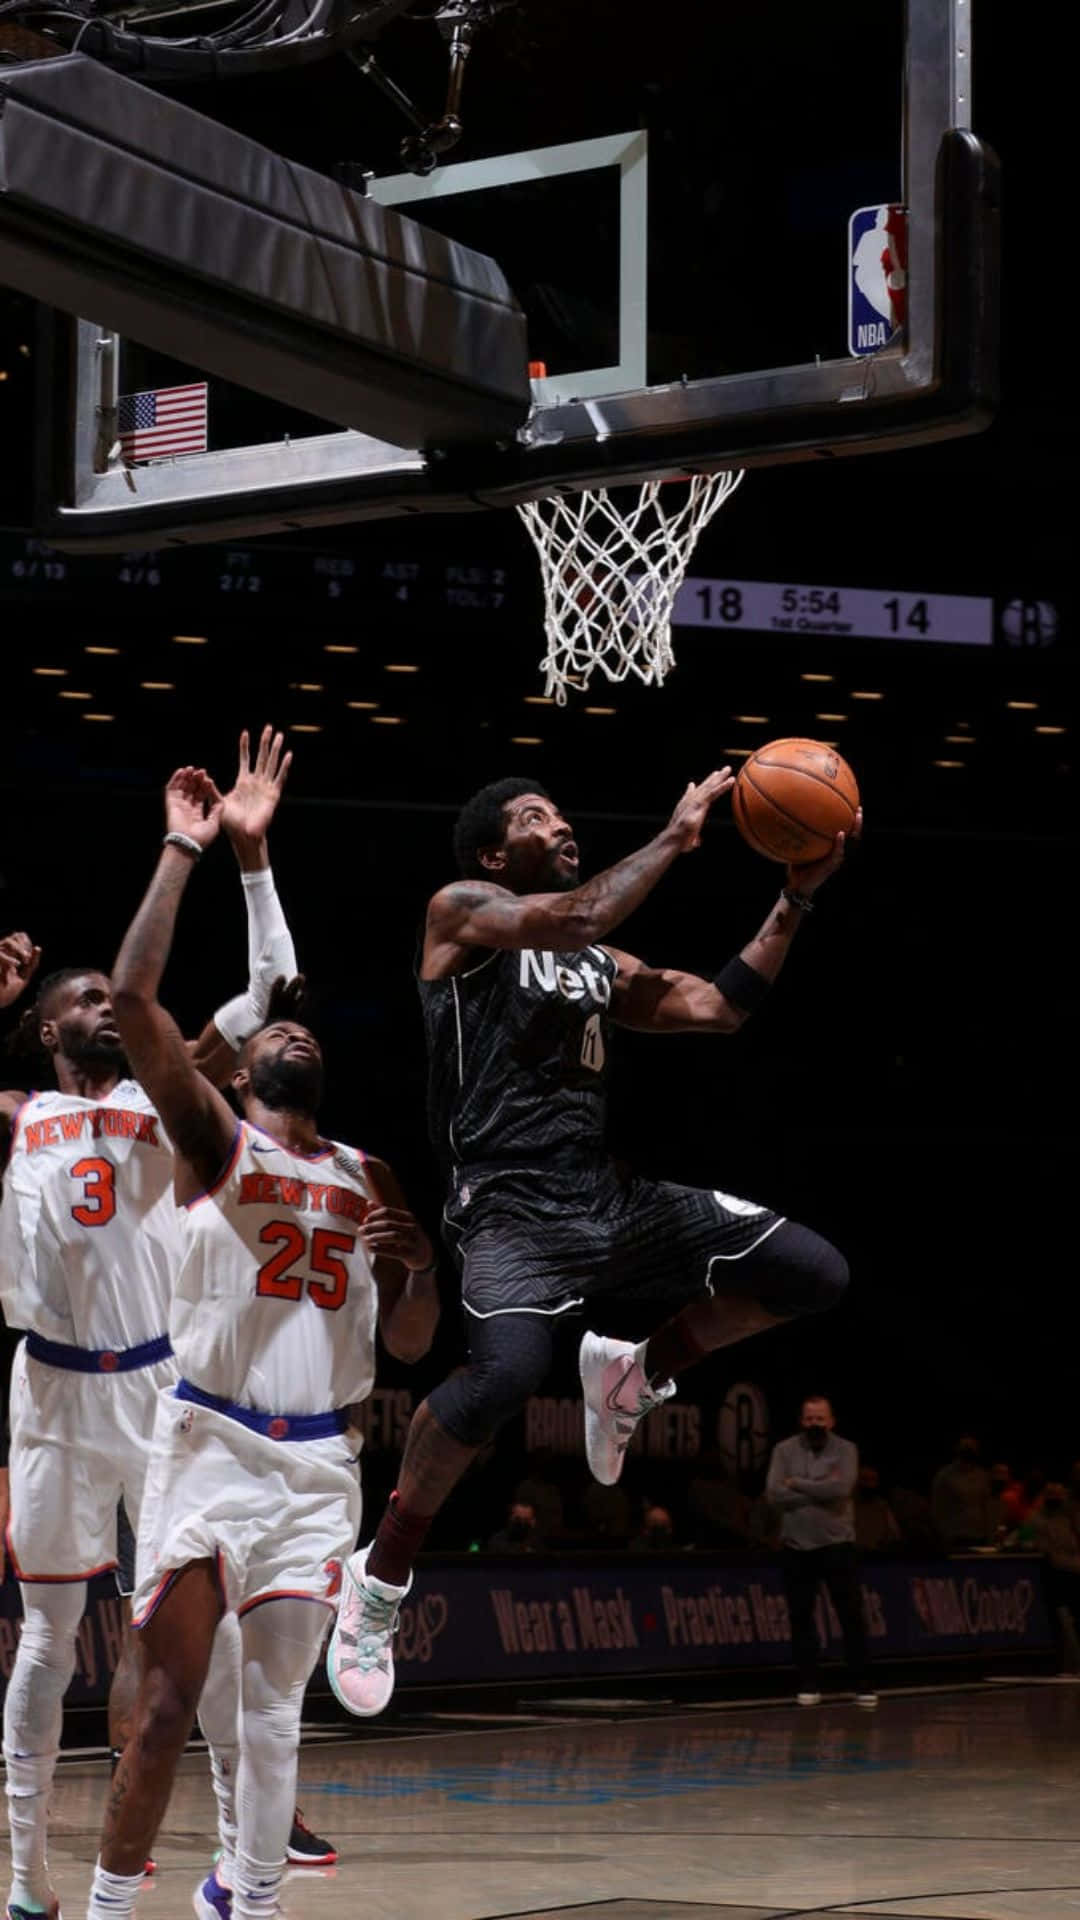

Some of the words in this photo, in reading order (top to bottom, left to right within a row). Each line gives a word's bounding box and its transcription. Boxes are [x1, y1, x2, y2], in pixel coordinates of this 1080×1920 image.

[857, 321, 886, 348] NBA
[696, 585, 743, 622] 18
[782, 589, 841, 615] 5:54
[884, 598, 930, 635] 14
[772, 617, 794, 630] 1st
[797, 619, 854, 633] Quarter
[25, 1112, 83, 1154] NEW
[87, 1108, 159, 1147] YORK
[71, 1157, 116, 1227] 3
[239, 1172, 304, 1206] NEW
[256, 1221, 355, 1310] 25
[489, 1588, 556, 1655] Wear
[556, 1600, 577, 1653] a
[572, 1586, 640, 1649] Mask
[661, 1584, 752, 1646] Practice
